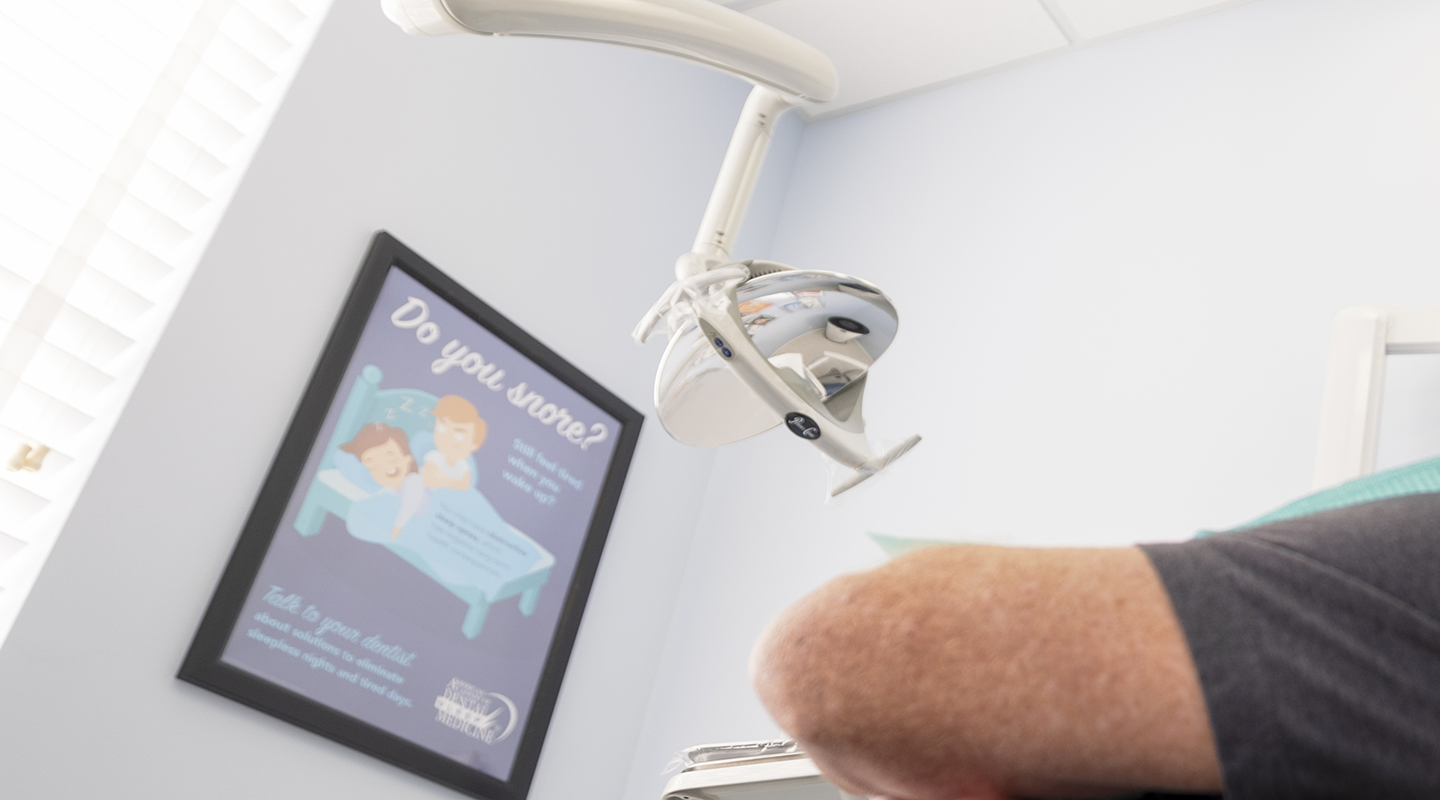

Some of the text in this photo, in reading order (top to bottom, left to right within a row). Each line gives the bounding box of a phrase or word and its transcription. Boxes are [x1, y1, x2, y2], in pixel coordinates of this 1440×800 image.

[390, 295, 609, 451] Do you snore?
[502, 469, 533, 494] wake
[507, 453, 561, 494] when you
[511, 437, 537, 459] Still
[558, 466, 585, 491] tired
[253, 611, 406, 686] about solutions to eliminate
[261, 584, 418, 667] Talk to your dentist
[246, 627, 301, 658] sleepless
[301, 651, 337, 674] nights
[336, 668, 360, 685] and
[359, 676, 388, 696] tired
[434, 709, 494, 746] MEDICINE
